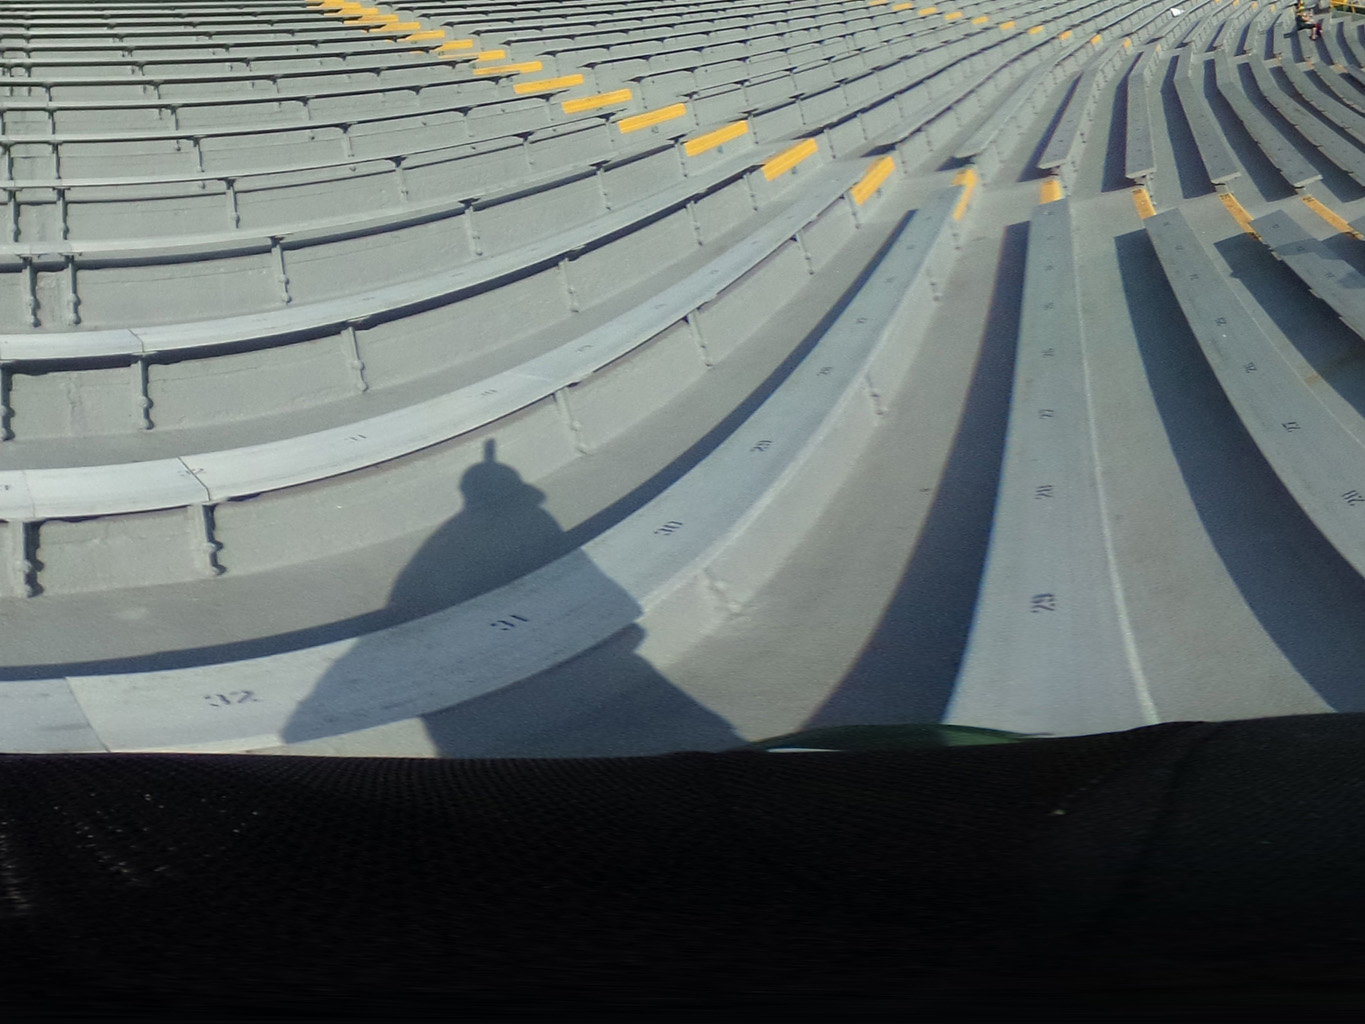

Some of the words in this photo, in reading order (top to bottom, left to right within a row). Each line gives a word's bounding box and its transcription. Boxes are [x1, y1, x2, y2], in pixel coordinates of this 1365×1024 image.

[1281, 421, 1301, 433] 27
[750, 439, 772, 452] 29
[1035, 484, 1053, 500] 28
[1342, 489, 1365, 507] 28
[654, 520, 683, 536] 30
[1031, 592, 1056, 614] 29
[489, 614, 529, 631] 31
[202, 689, 261, 708] 32
